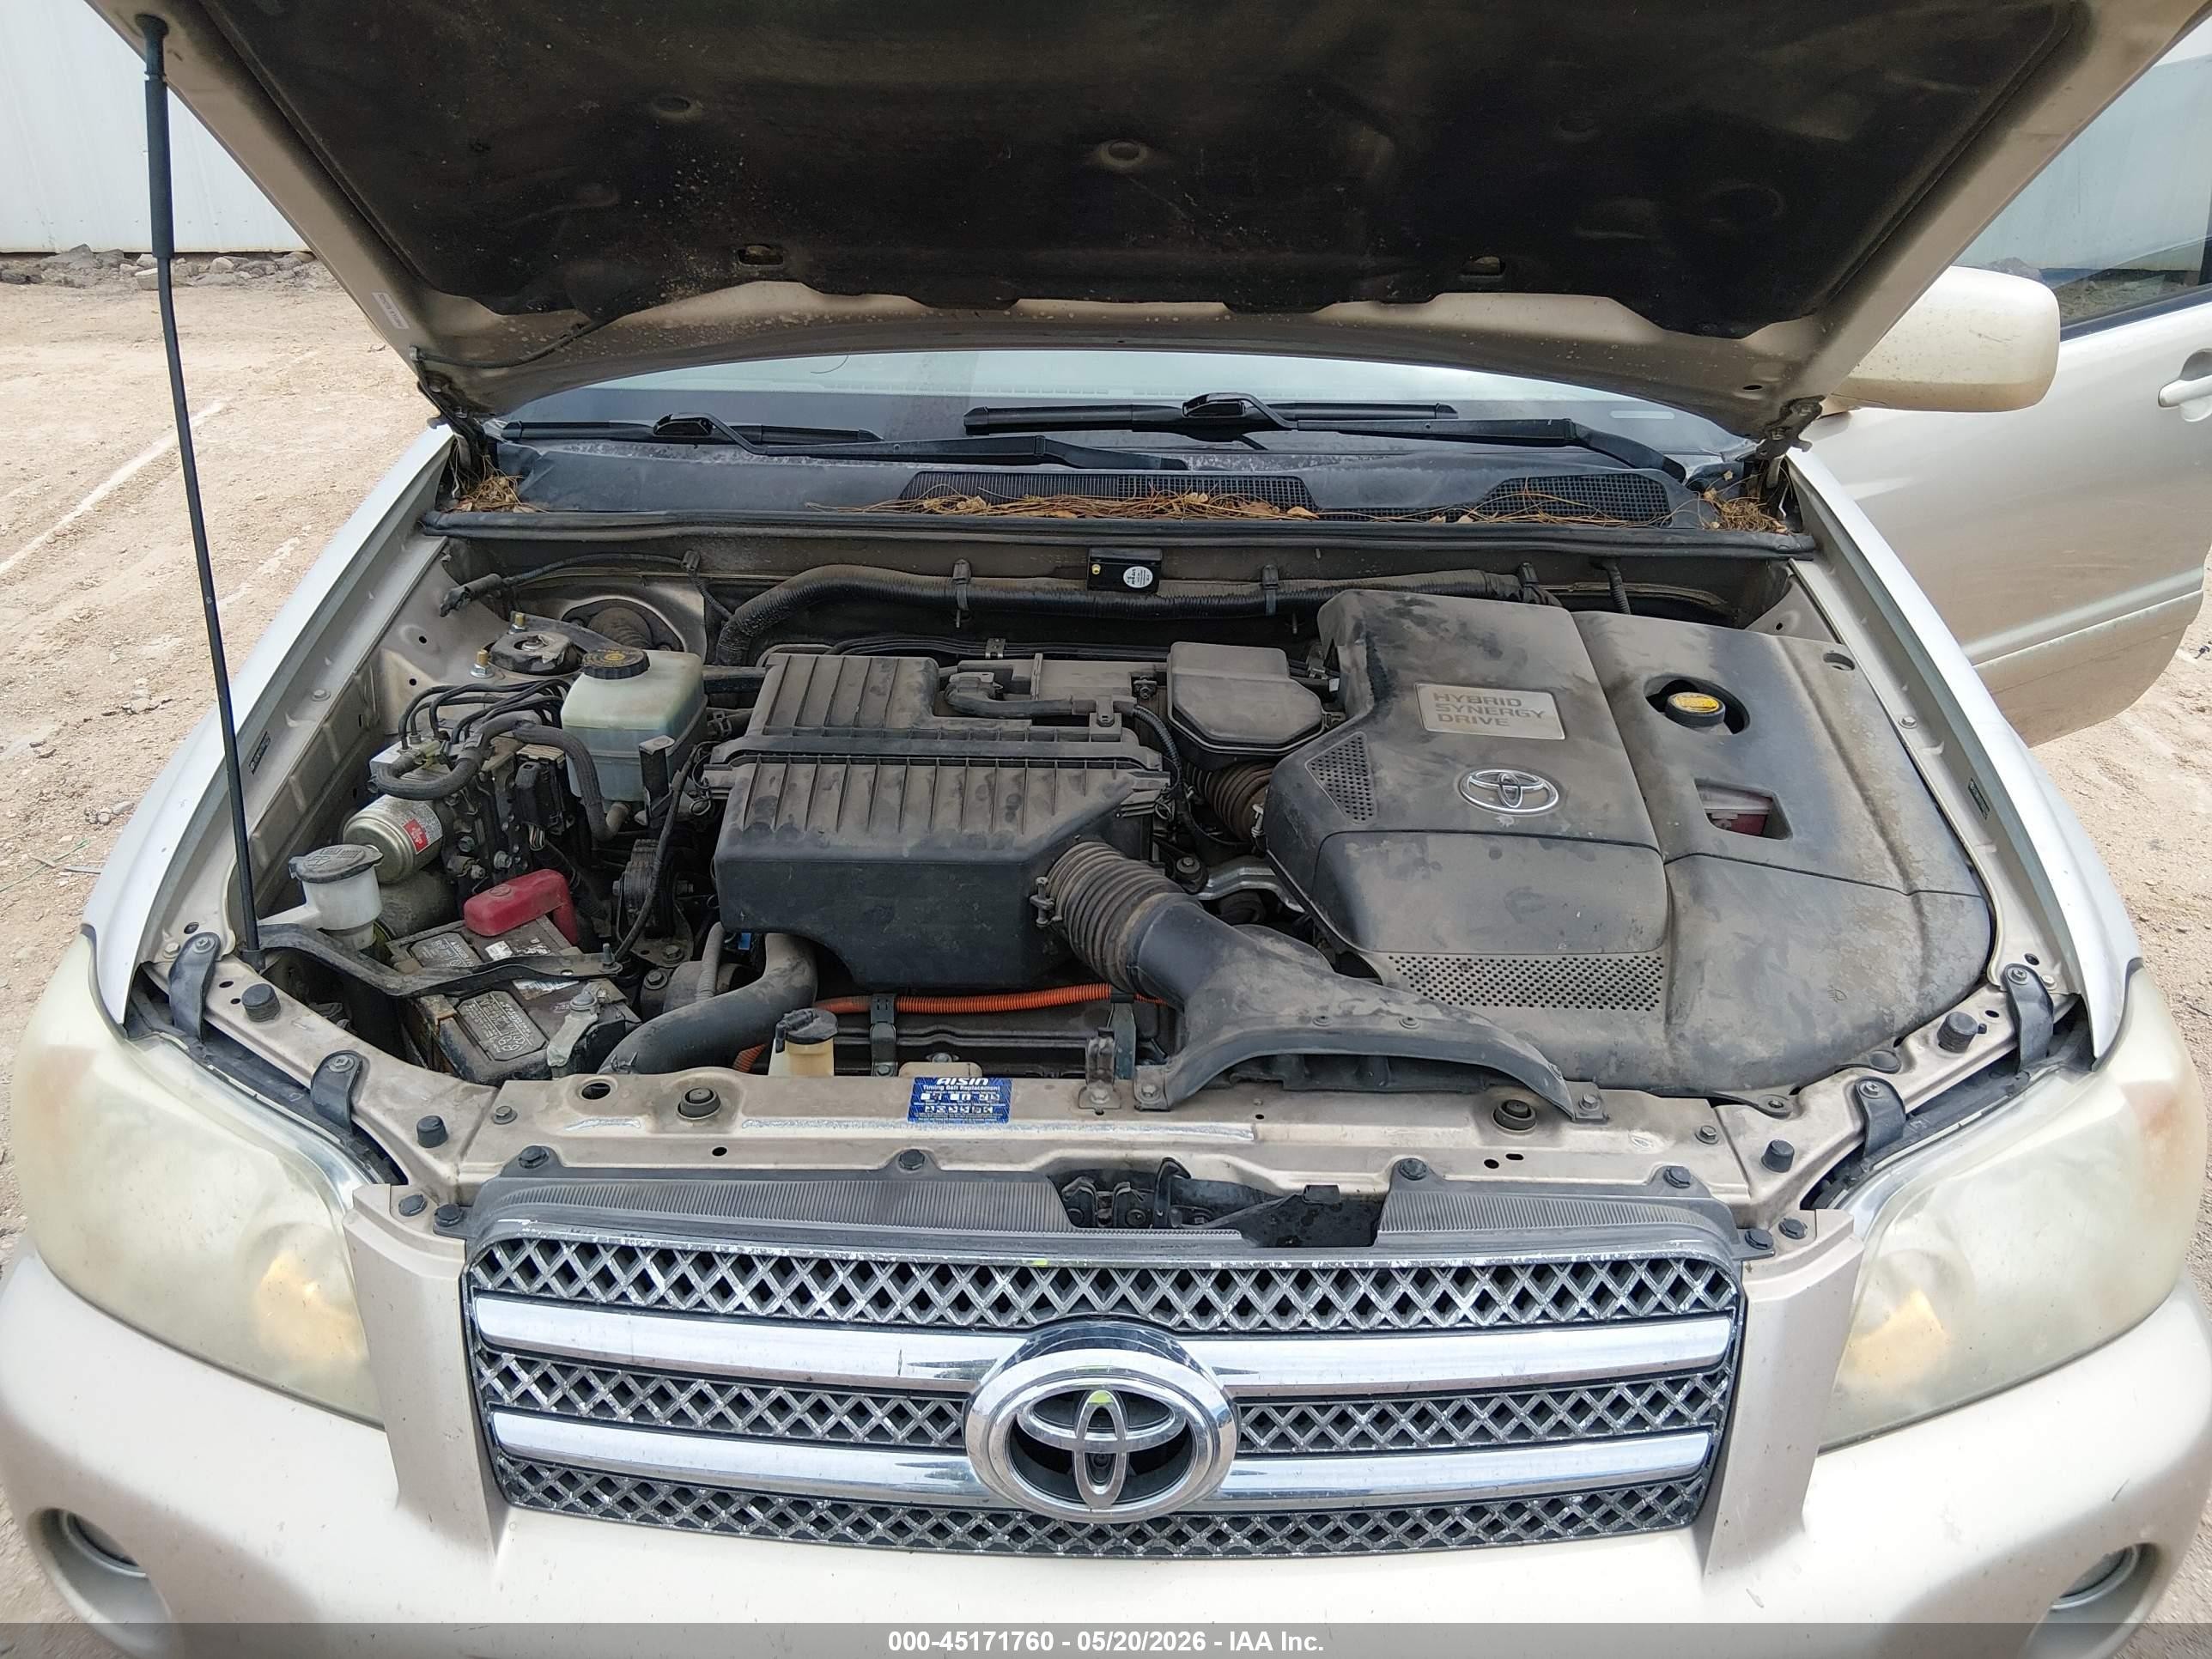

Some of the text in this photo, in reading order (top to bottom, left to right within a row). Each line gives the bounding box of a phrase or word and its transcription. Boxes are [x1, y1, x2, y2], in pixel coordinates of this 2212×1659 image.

[1433, 693, 1522, 708] HYBRID
[1435, 703, 1546, 719] SYNERGY
[1438, 714, 1510, 727] DRIVE
[936, 1077, 988, 1085] AISIN
